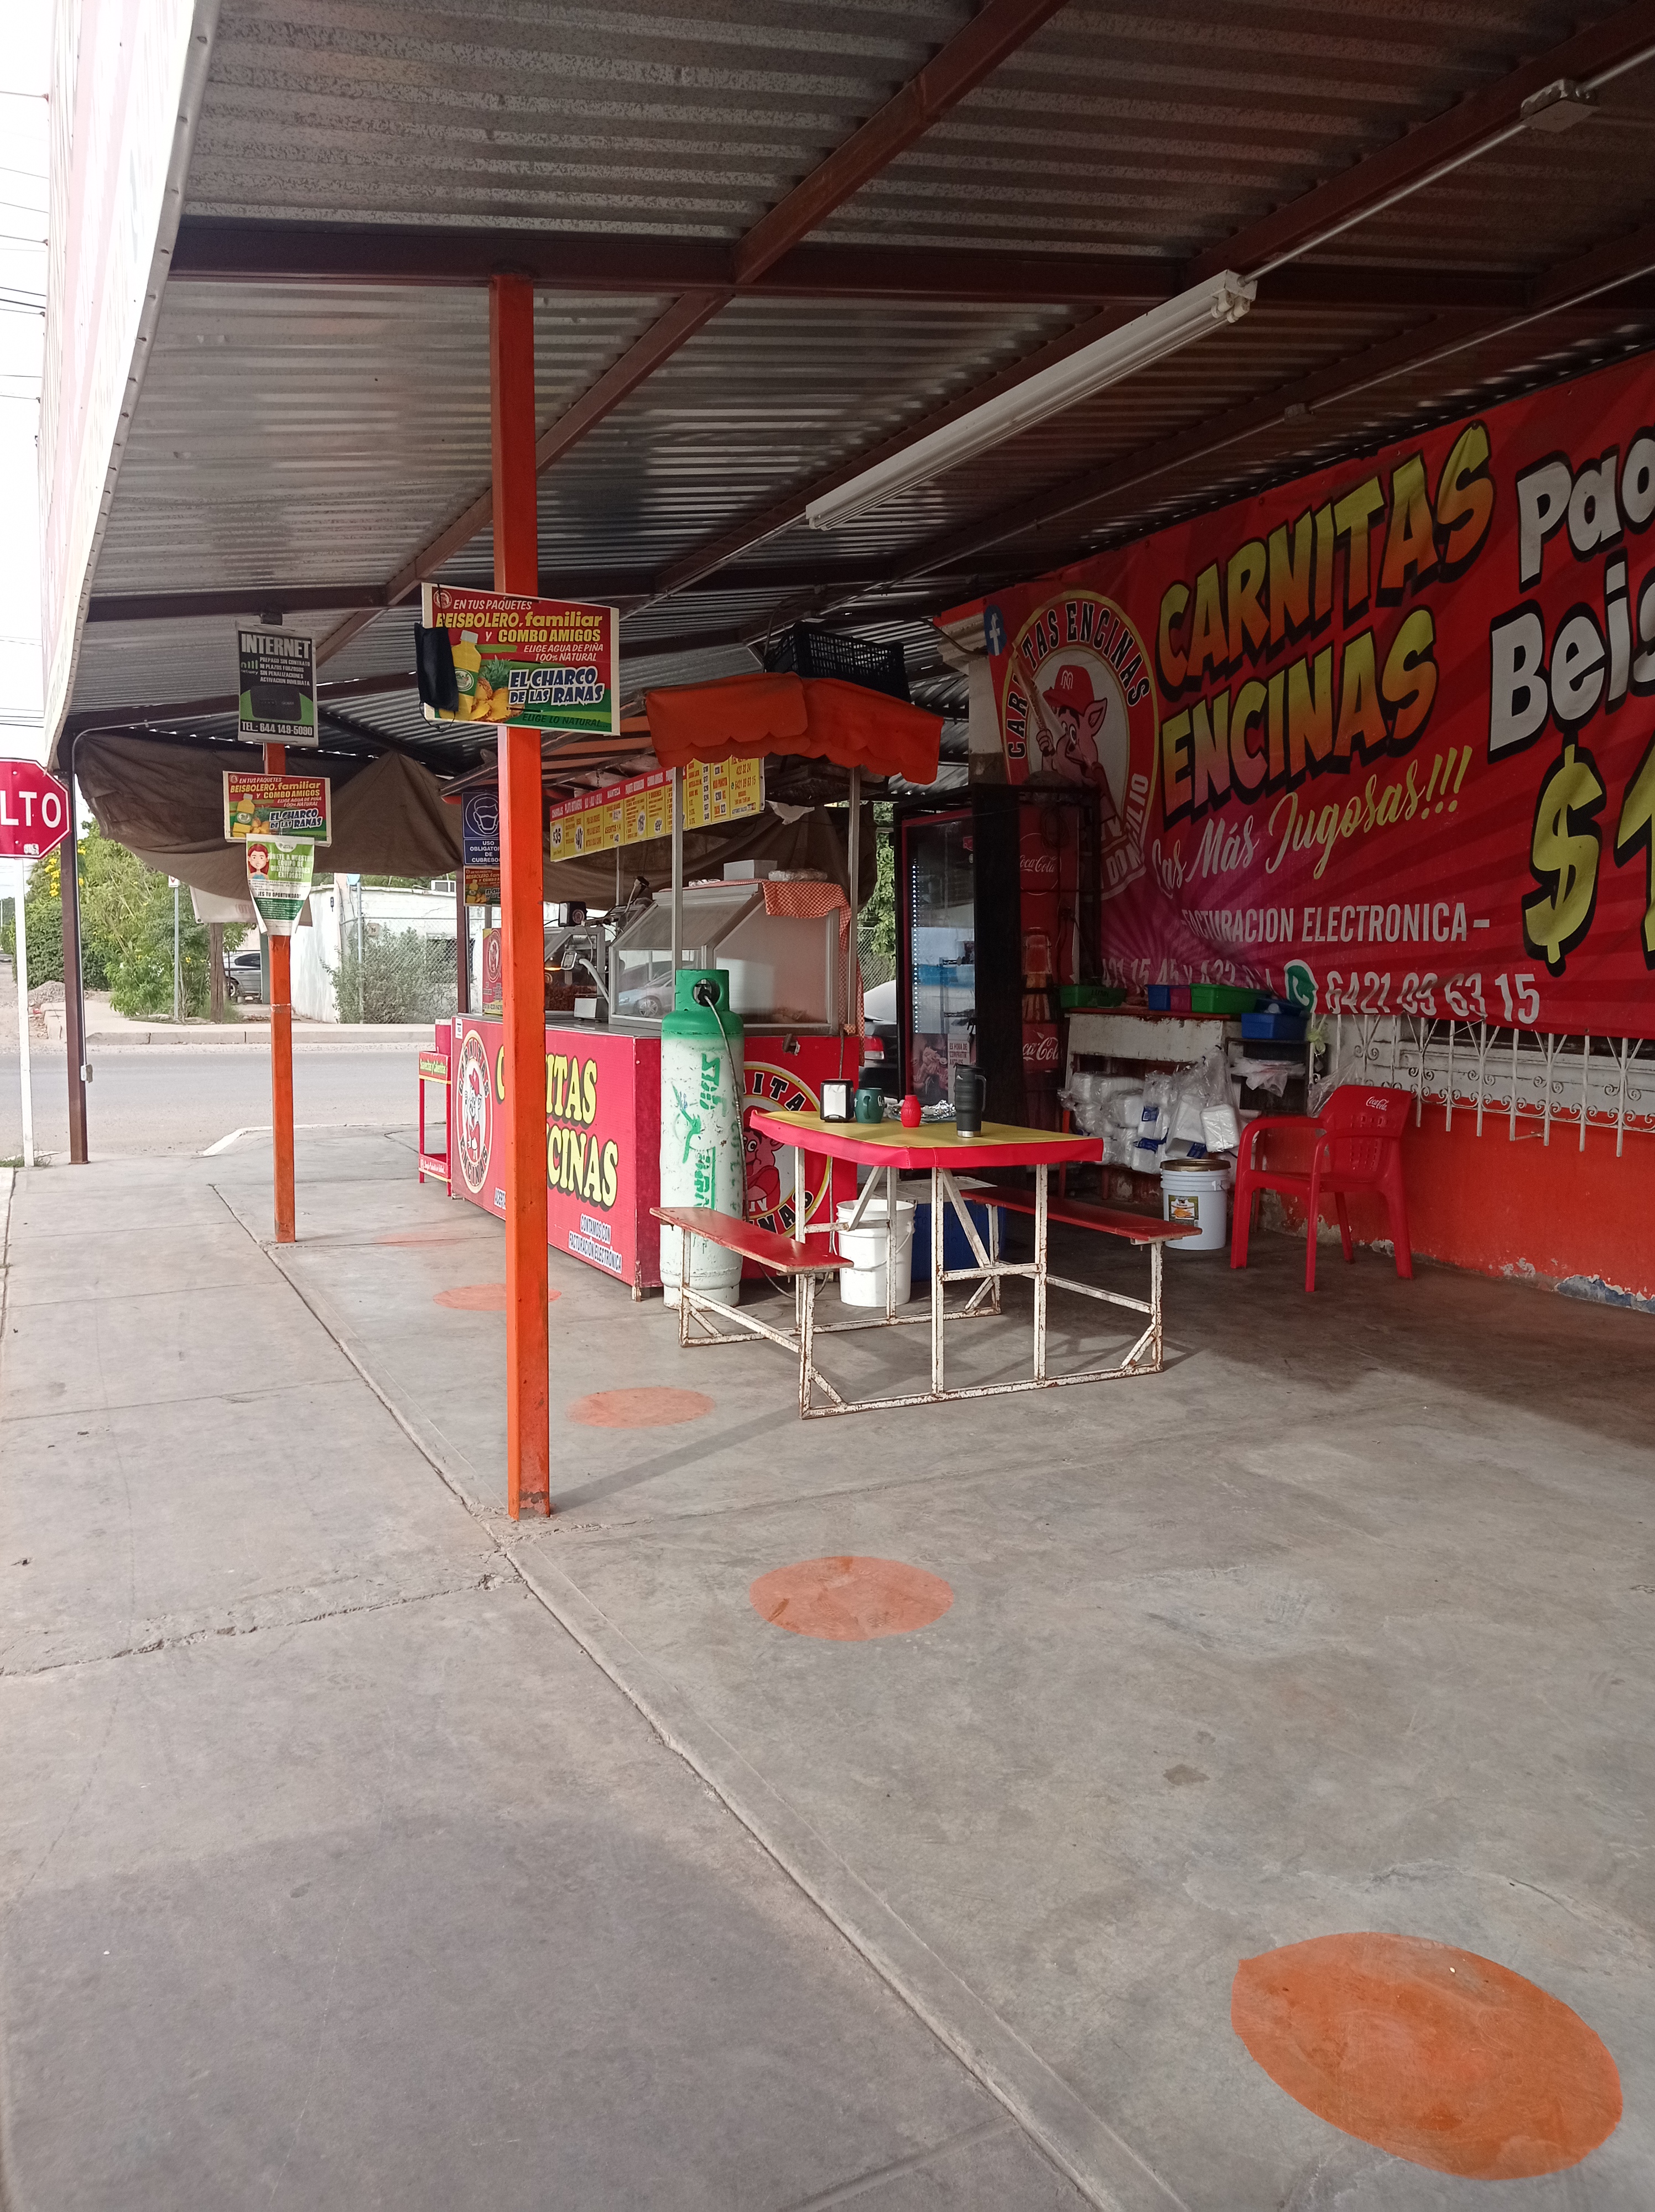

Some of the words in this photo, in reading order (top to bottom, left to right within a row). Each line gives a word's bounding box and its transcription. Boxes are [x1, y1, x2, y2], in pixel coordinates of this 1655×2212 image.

[1158, 424, 1495, 688] CARNITAS
[453, 599, 468, 610] EN
[469, 599, 484, 610] TUS
[486, 600, 532, 610] PAQUETES
[525, 611, 603, 628] familiar
[498, 629, 547, 643] COMBO
[549, 629, 601, 643] AMIGOS
[241, 633, 311, 659] INTERNET
[523, 644, 547, 653] ELIGE
[547, 644, 571, 653] AGUA
[584, 641, 603, 652] PIÑA
[535, 653, 558, 661] 100%
[559, 653, 597, 661] NATURAL
[509, 668, 530, 688] EL
[532, 666, 598, 687] CHARCO
[1007, 615, 1060, 759] CARTAS
[1065, 601, 1151, 708] ENCINAS
[509, 690, 525, 704] DE
[529, 691, 550, 703] LAS
[553, 684, 604, 705] RANAS
[1160, 608, 1439, 819] ENCINAS
[259, 723, 276, 733] 644
[263, 791, 289, 799] COMBO
[291, 789, 320, 797] AMIGOS
[278, 781, 321, 790] familiar
[270, 812, 281, 821] EL
[282, 809, 318, 820] CHARCO
[294, 817, 322, 828] RANAS
[1185, 815, 1260, 883] Más
[1266, 745, 1472, 880] Jugosas!!!
[1325, 971, 1391, 1015] 6421
[1444, 973, 1488, 1018] 63
[1495, 973, 1540, 1024] 15
[1366, 1096, 1389, 1111] Coca-Cola
[547, 1123, 618, 1207] CINAS
[580, 1214, 602, 1239] CONTAMOS
[602, 1224, 611, 1243] CON
